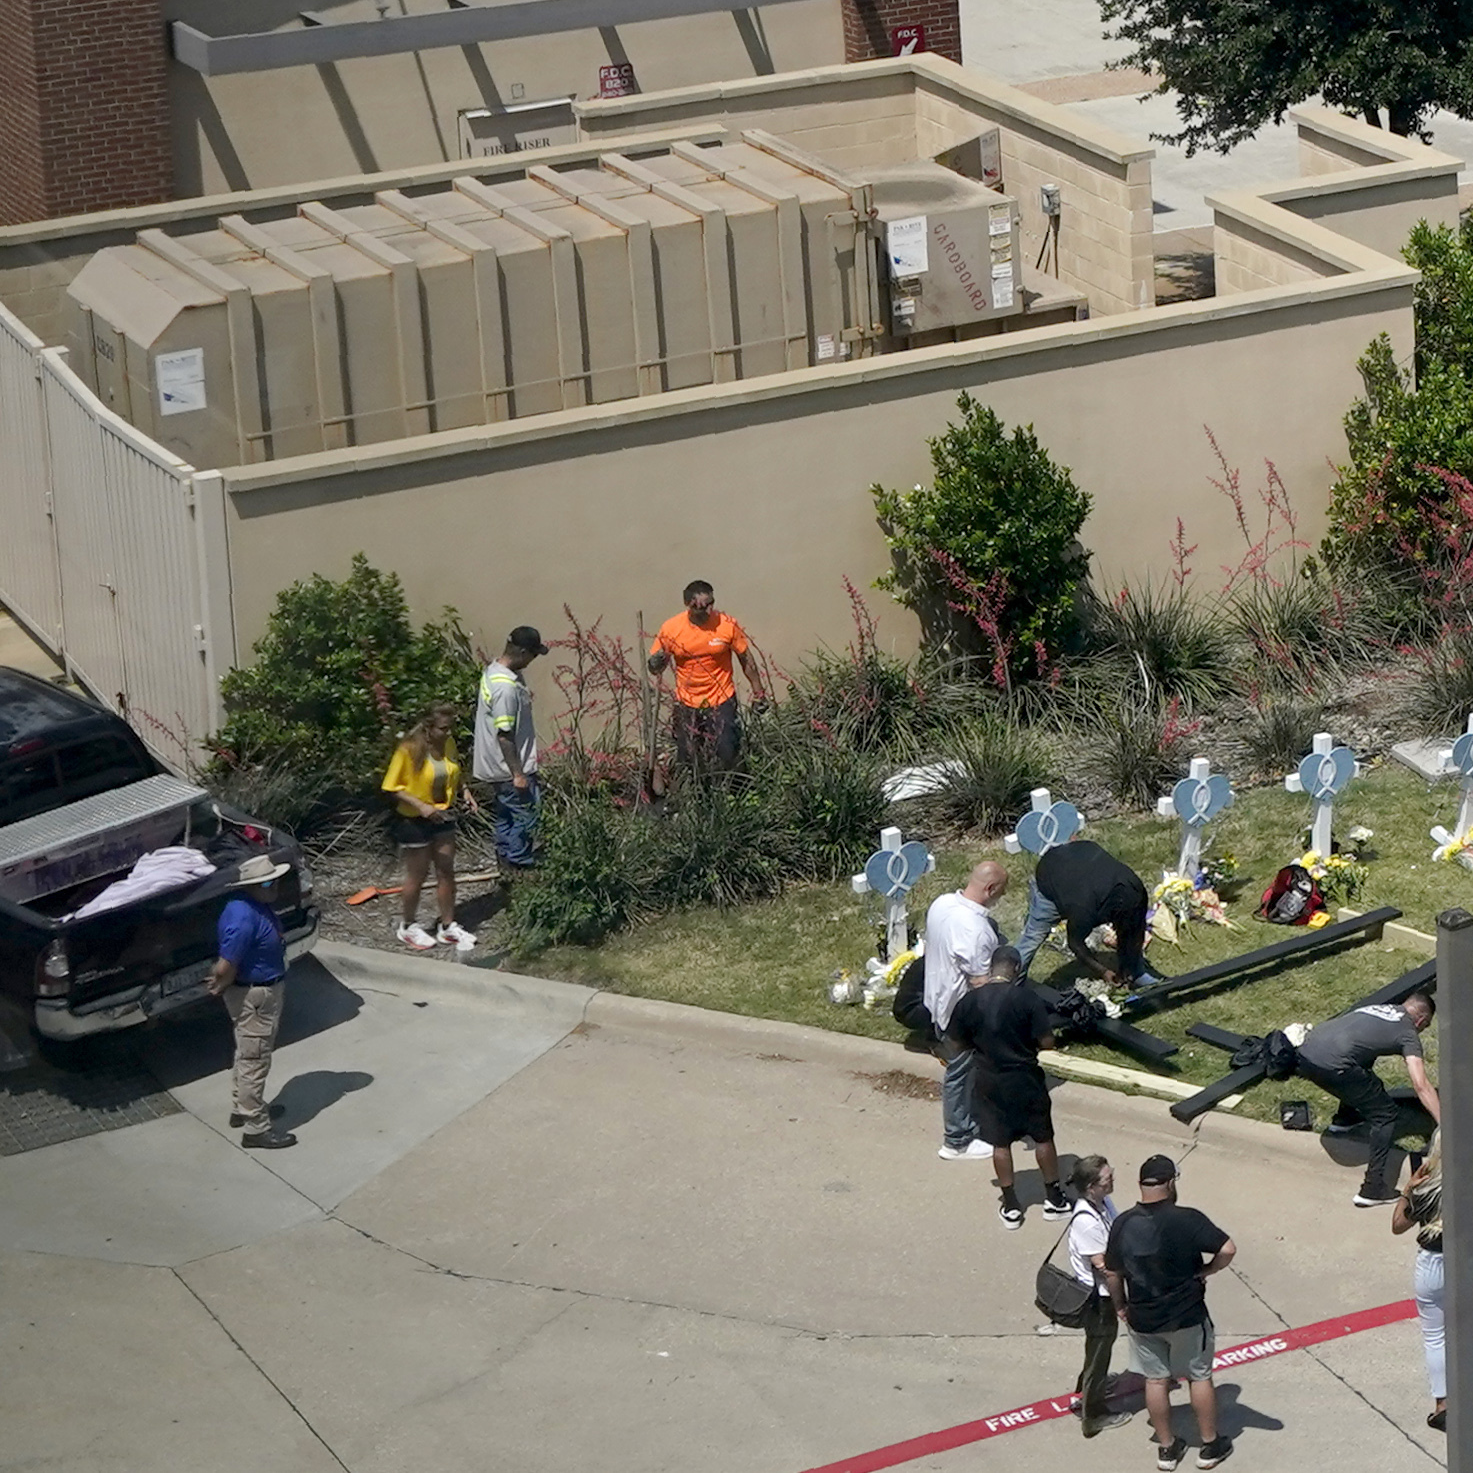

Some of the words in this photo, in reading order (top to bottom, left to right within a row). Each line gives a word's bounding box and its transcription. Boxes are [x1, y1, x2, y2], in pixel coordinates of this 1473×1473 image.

[483, 143, 512, 157] FIRE
[515, 137, 551, 154] RISER
[933, 223, 987, 311] CARDBOARD
[985, 1407, 1040, 1433] FIRE
[1211, 1338, 1288, 1369] ARKING
